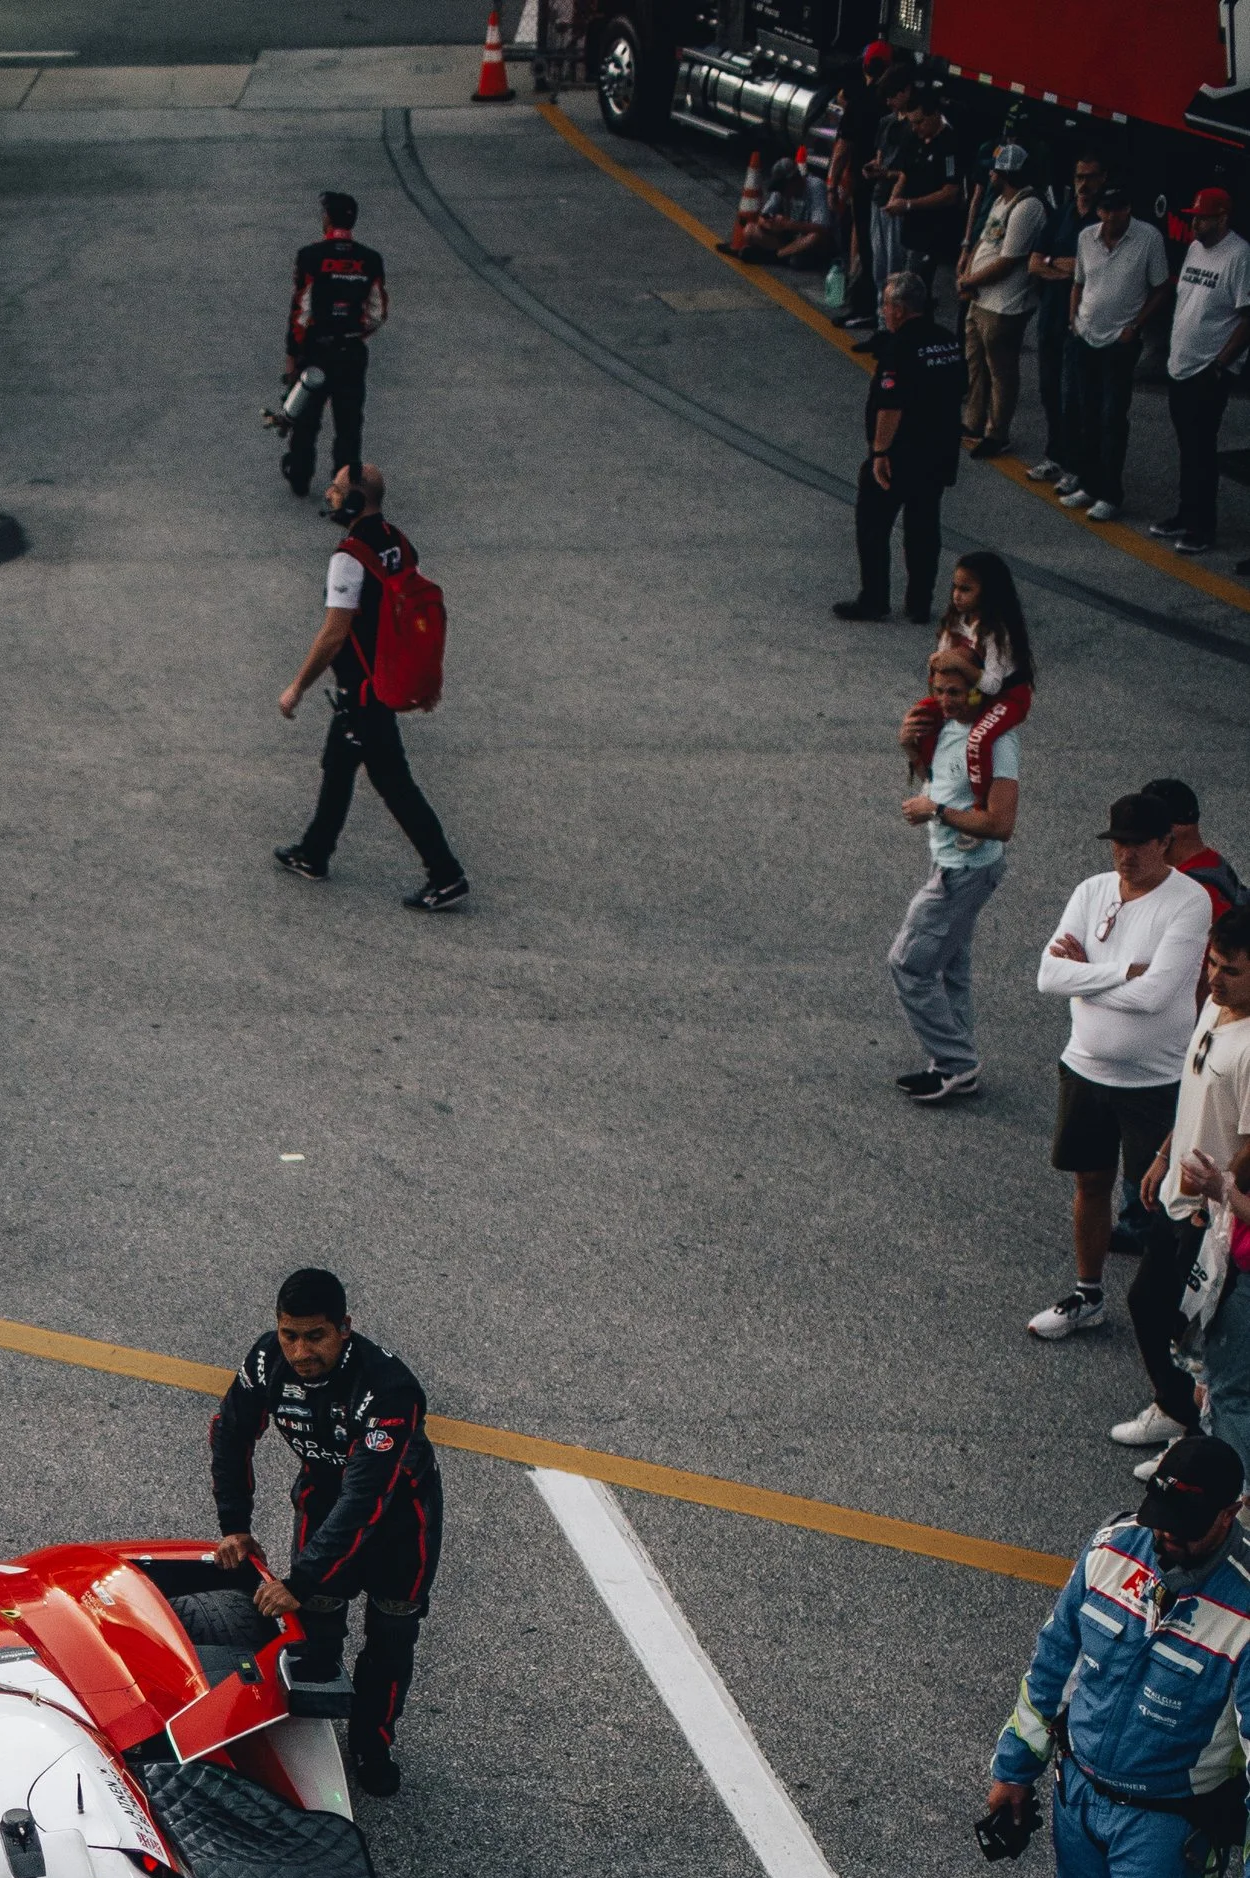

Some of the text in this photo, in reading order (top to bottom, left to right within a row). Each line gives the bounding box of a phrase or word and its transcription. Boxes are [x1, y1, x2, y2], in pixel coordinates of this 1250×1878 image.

[321, 258, 365, 272] DEX
[917, 342, 960, 357] CADILLA
[105, 1780, 141, 1820] AITKEN
